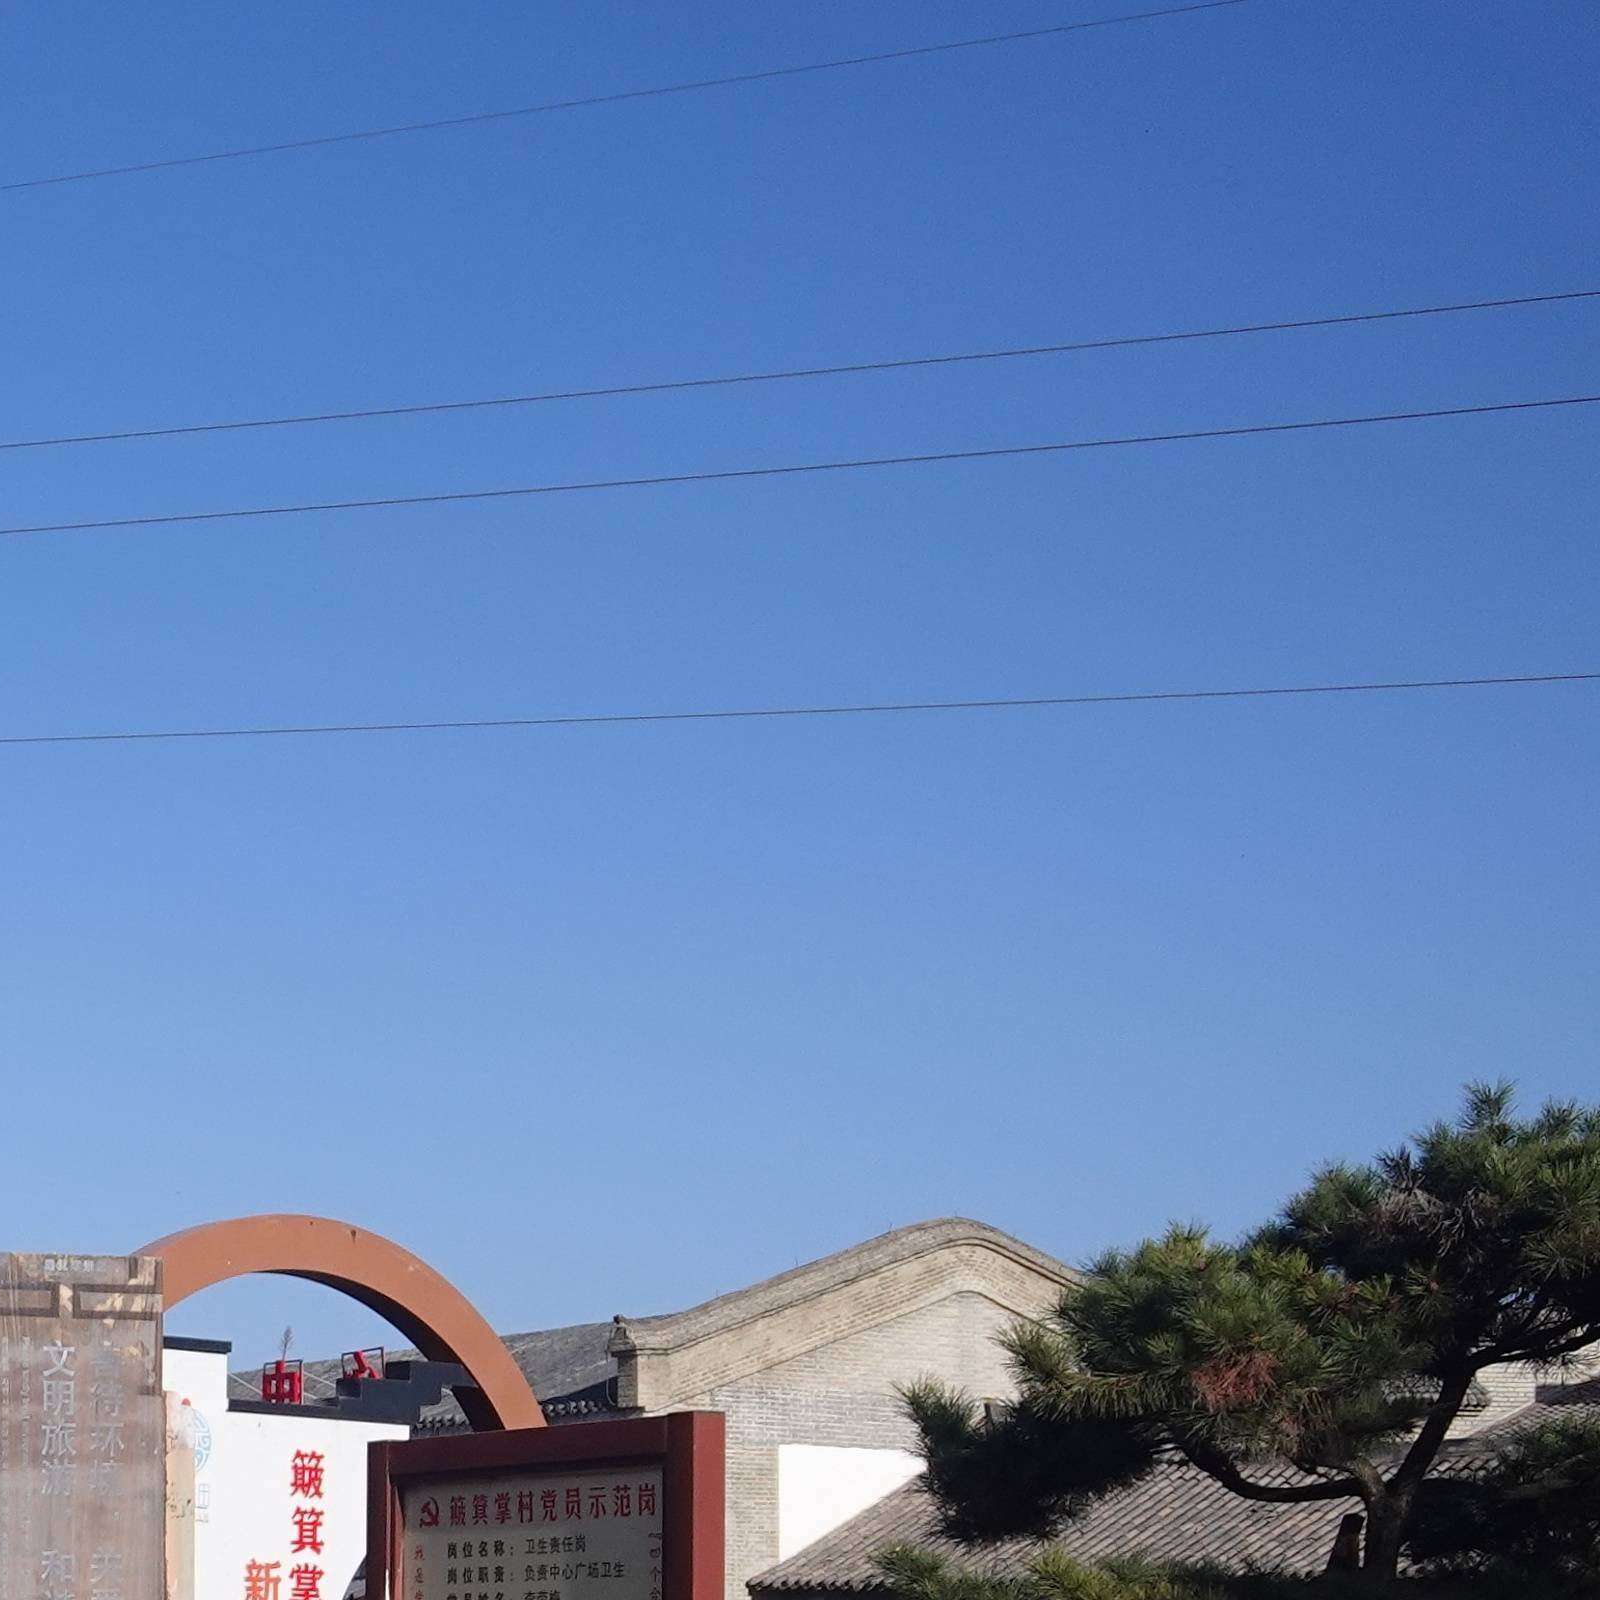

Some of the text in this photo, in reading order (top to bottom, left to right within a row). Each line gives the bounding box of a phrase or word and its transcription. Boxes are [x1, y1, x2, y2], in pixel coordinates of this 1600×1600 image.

[450, 1483, 657, 1527] 簸箕掌村党员示范岗
[525, 1535, 587, 1556] 卫生责任岗
